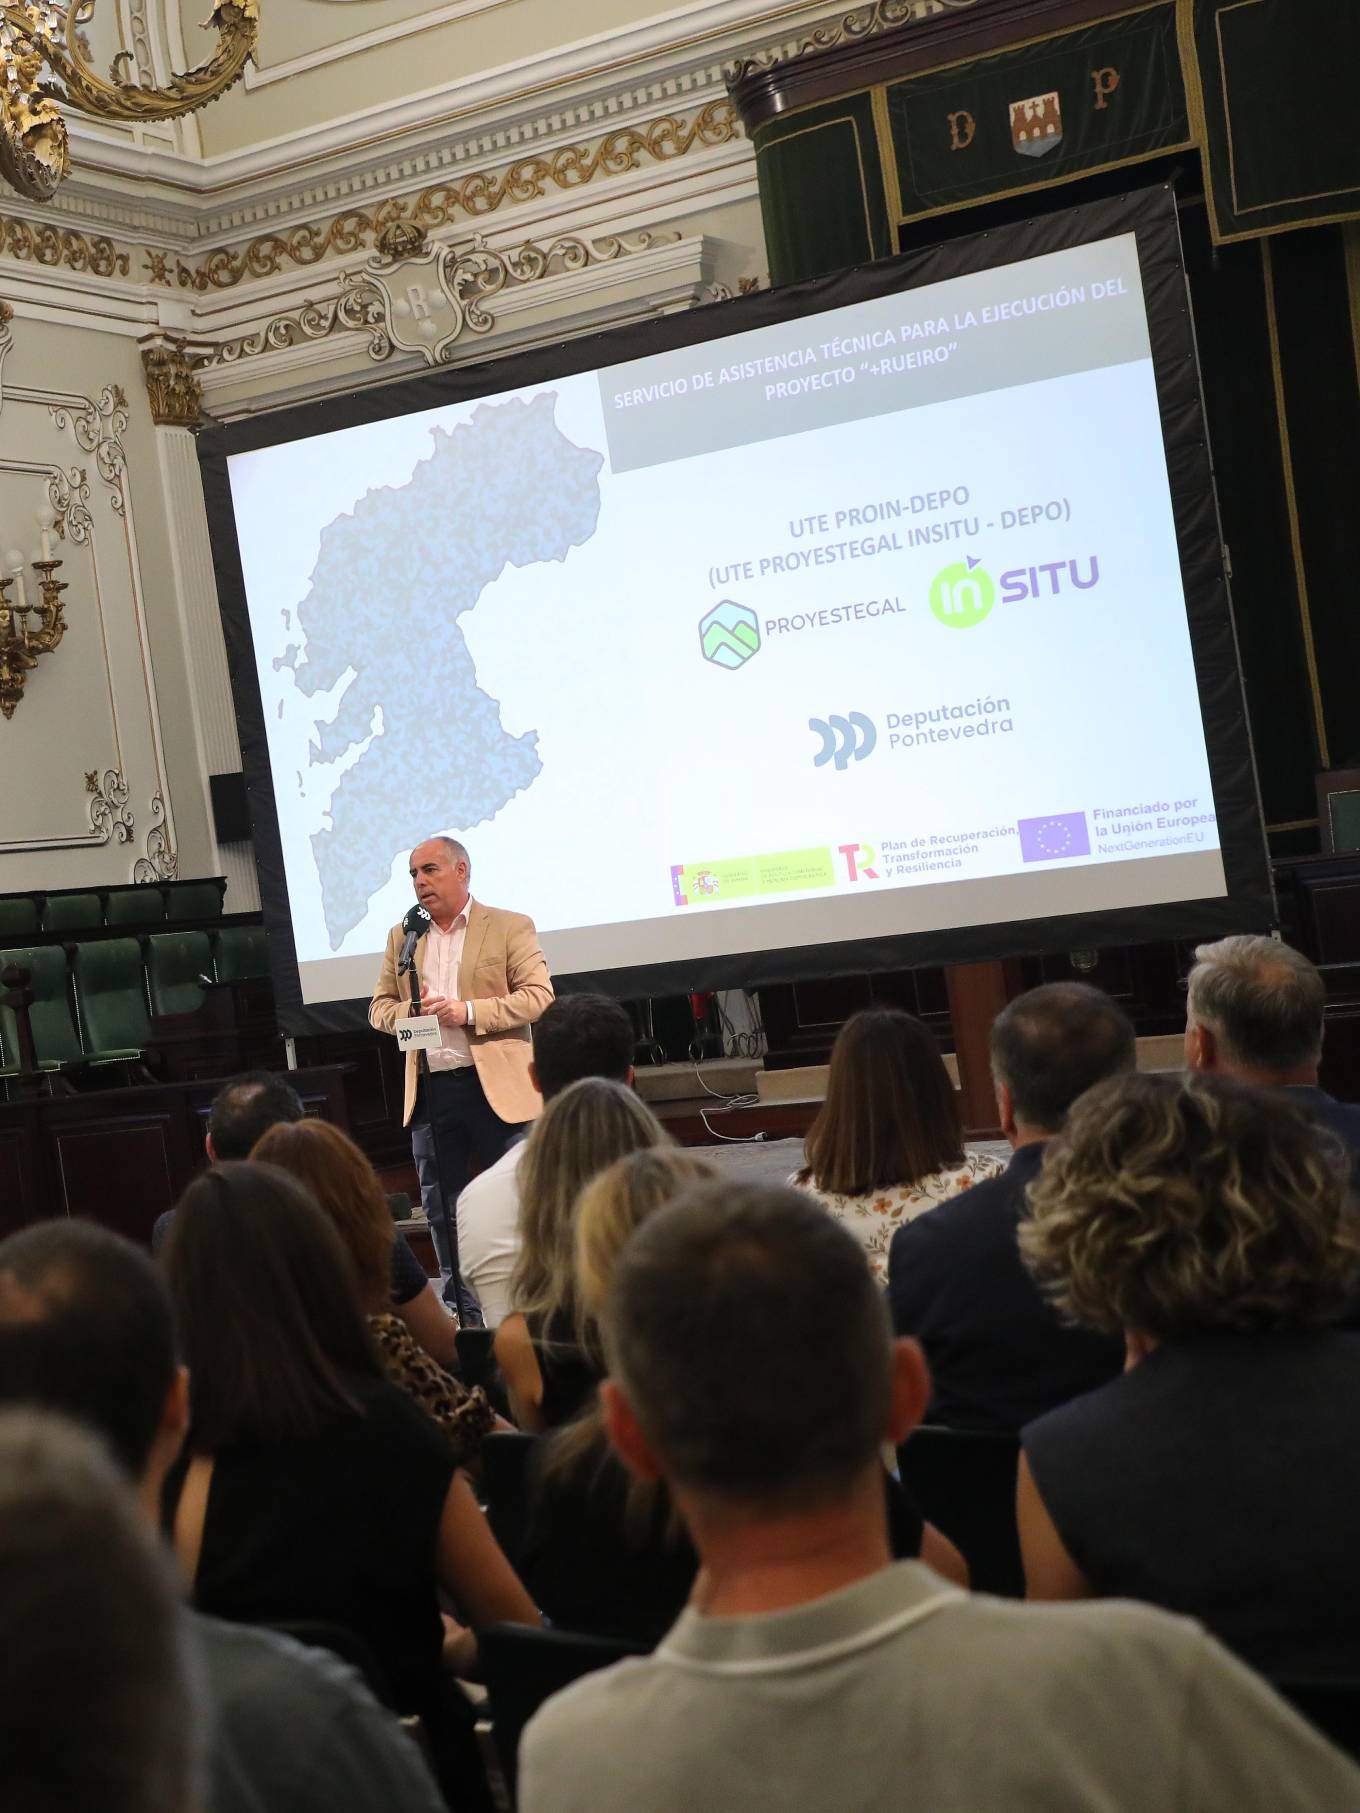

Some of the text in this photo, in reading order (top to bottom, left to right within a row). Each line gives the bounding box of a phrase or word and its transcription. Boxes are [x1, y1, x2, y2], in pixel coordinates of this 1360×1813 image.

[614, 278, 1128, 409] SERVICIO DE ASISTENCIA TÉCNICA PARA LA EJECUCIÓN DEL
[764, 366, 856, 400] PROYECTO
[789, 486, 970, 538] UTE PROIN-DEPO
[709, 561, 755, 590] (UTE
[759, 532, 903, 576] PROYESTEGAL
[907, 517, 980, 548] INSITU
[1000, 497, 1071, 530] DEPO)
[999, 555, 1100, 604] SITU
[765, 596, 907, 637] PROYESTEGAL
[886, 695, 1011, 731] Deputación
[889, 718, 1013, 749] Pontevedra
[1093, 798, 1198, 821] Financiado por
[1095, 812, 1217, 837] la Unión Europea
[881, 825, 1020, 852] Plan de Recuperación,
[882, 844, 979, 864] Transformación
[1097, 832, 1205, 855] NextGenerationEU
[885, 858, 963, 878] y Resiliencia
